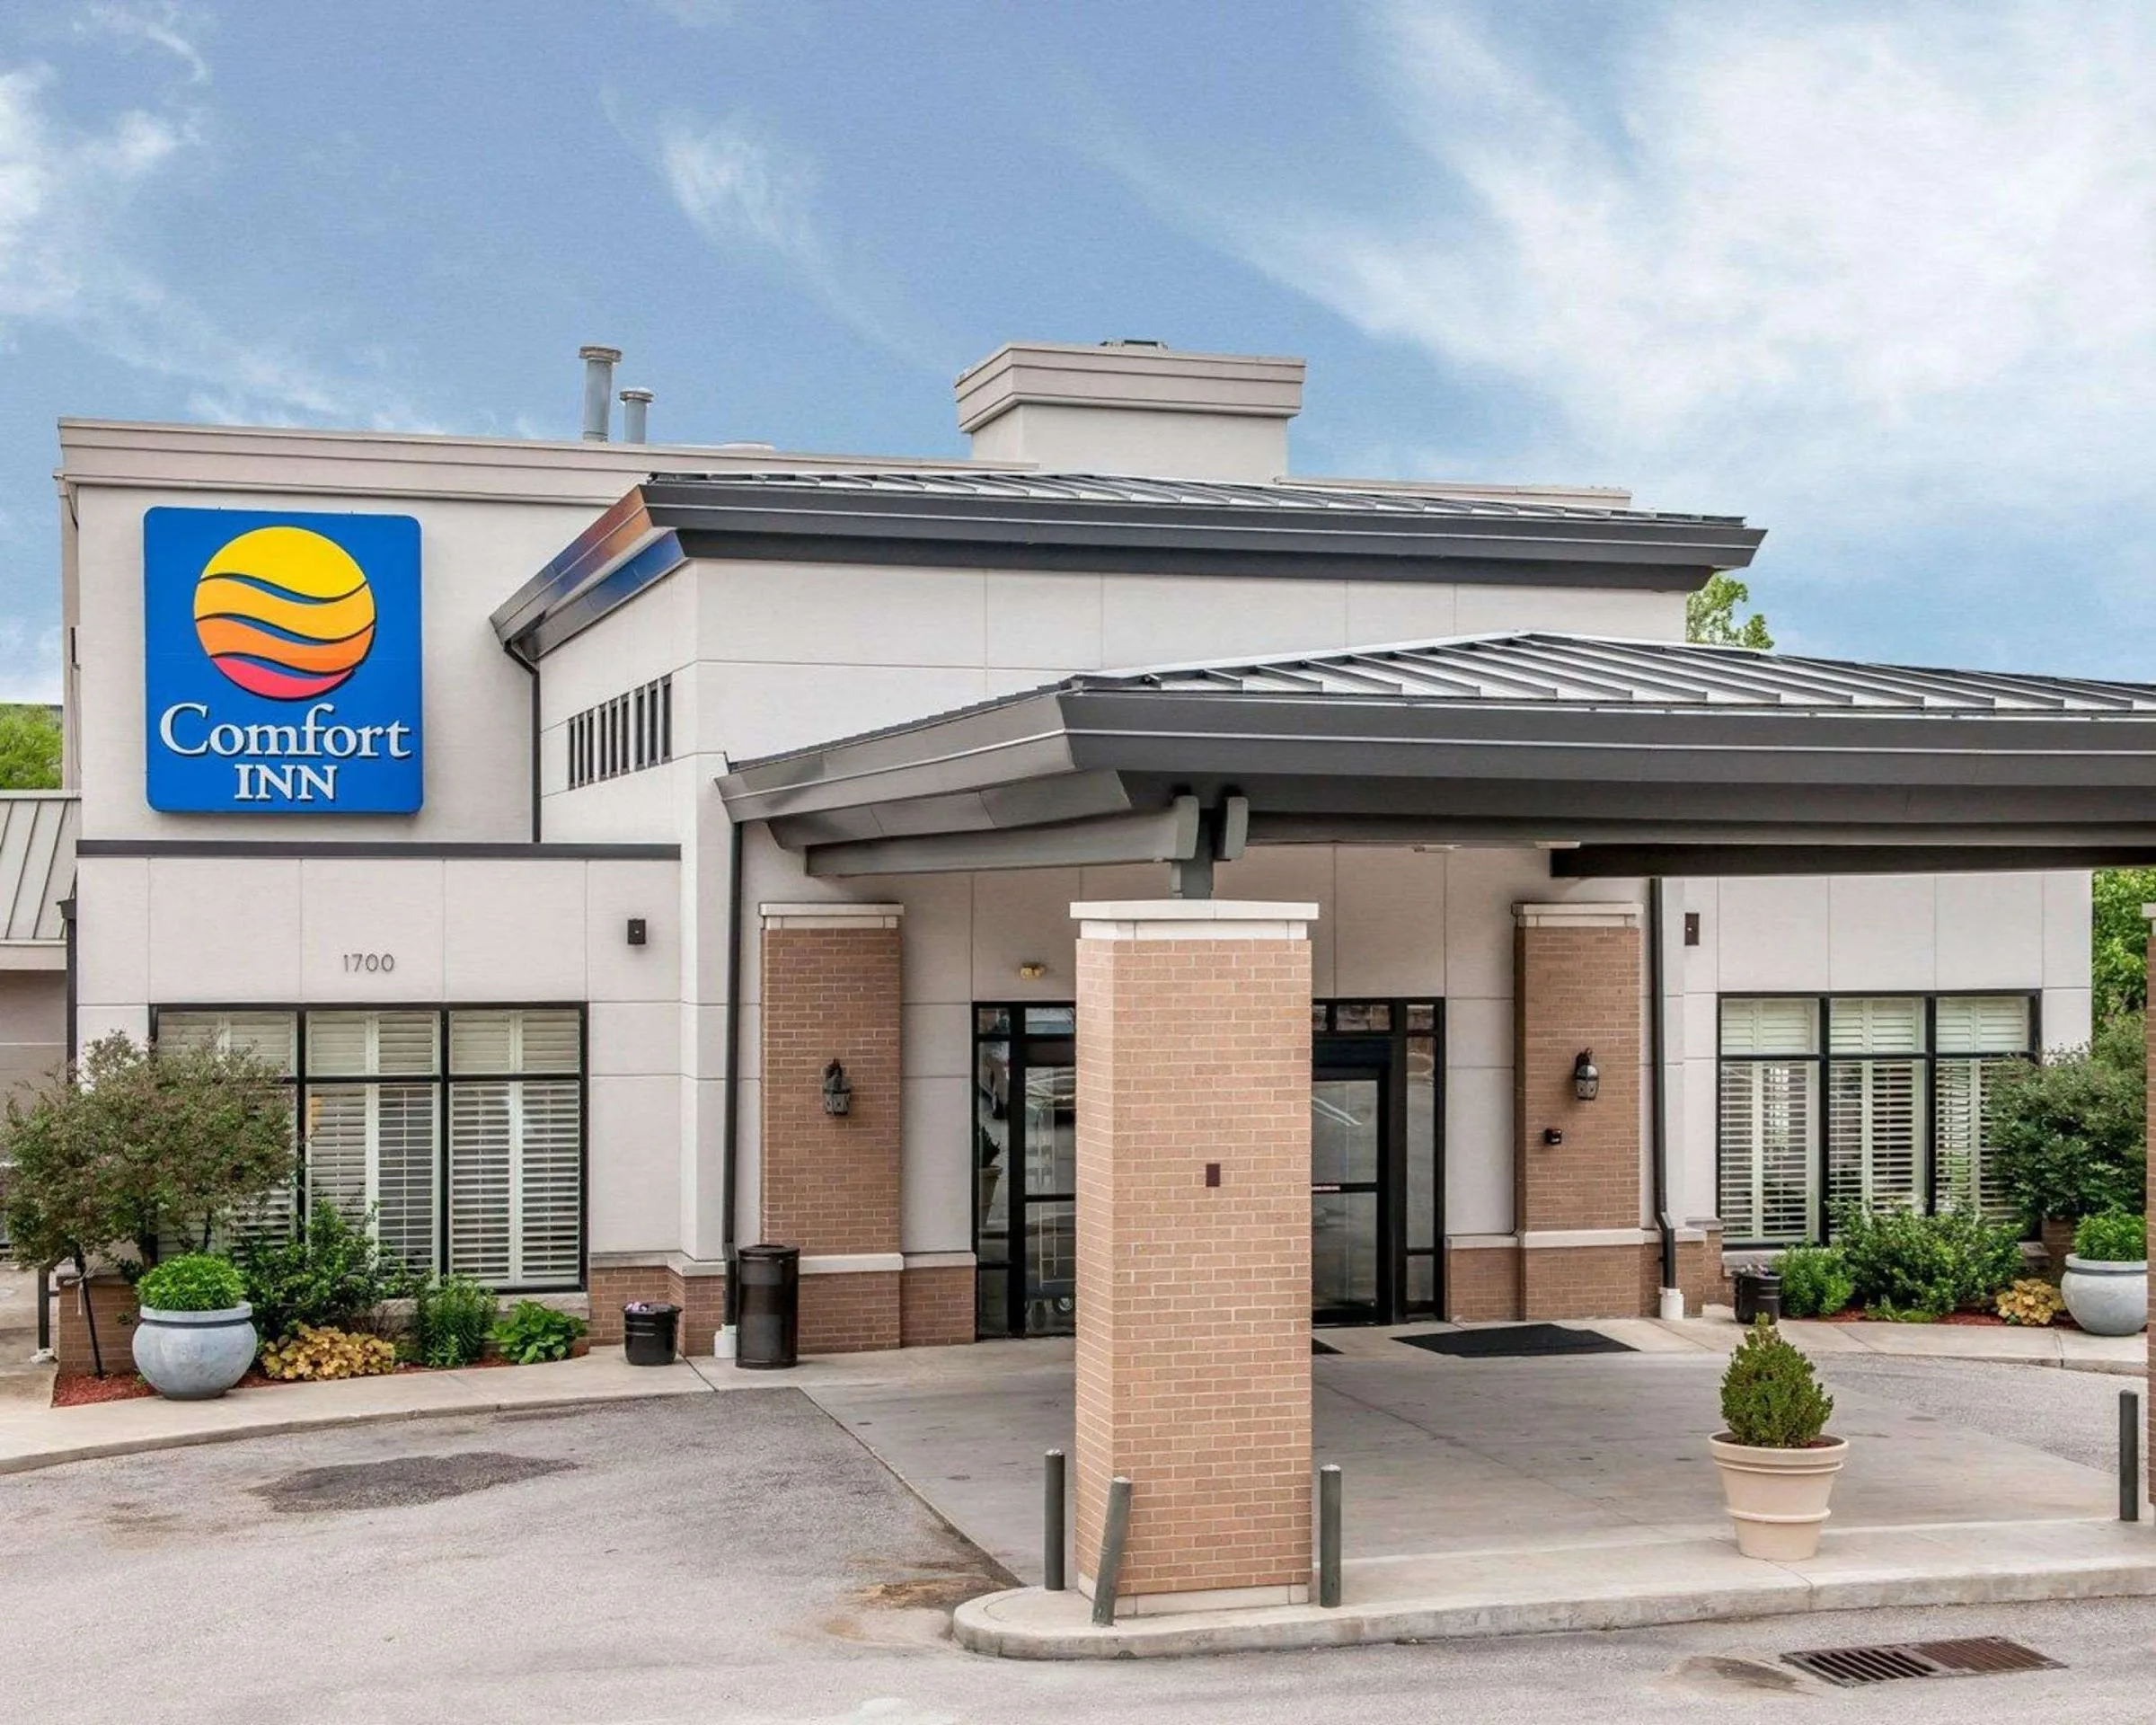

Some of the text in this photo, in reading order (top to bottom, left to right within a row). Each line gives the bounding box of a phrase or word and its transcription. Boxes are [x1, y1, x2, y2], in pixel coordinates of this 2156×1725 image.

[160, 703, 412, 758] Comfort
[234, 764, 338, 800] INN
[343, 953, 394, 972] 1700
